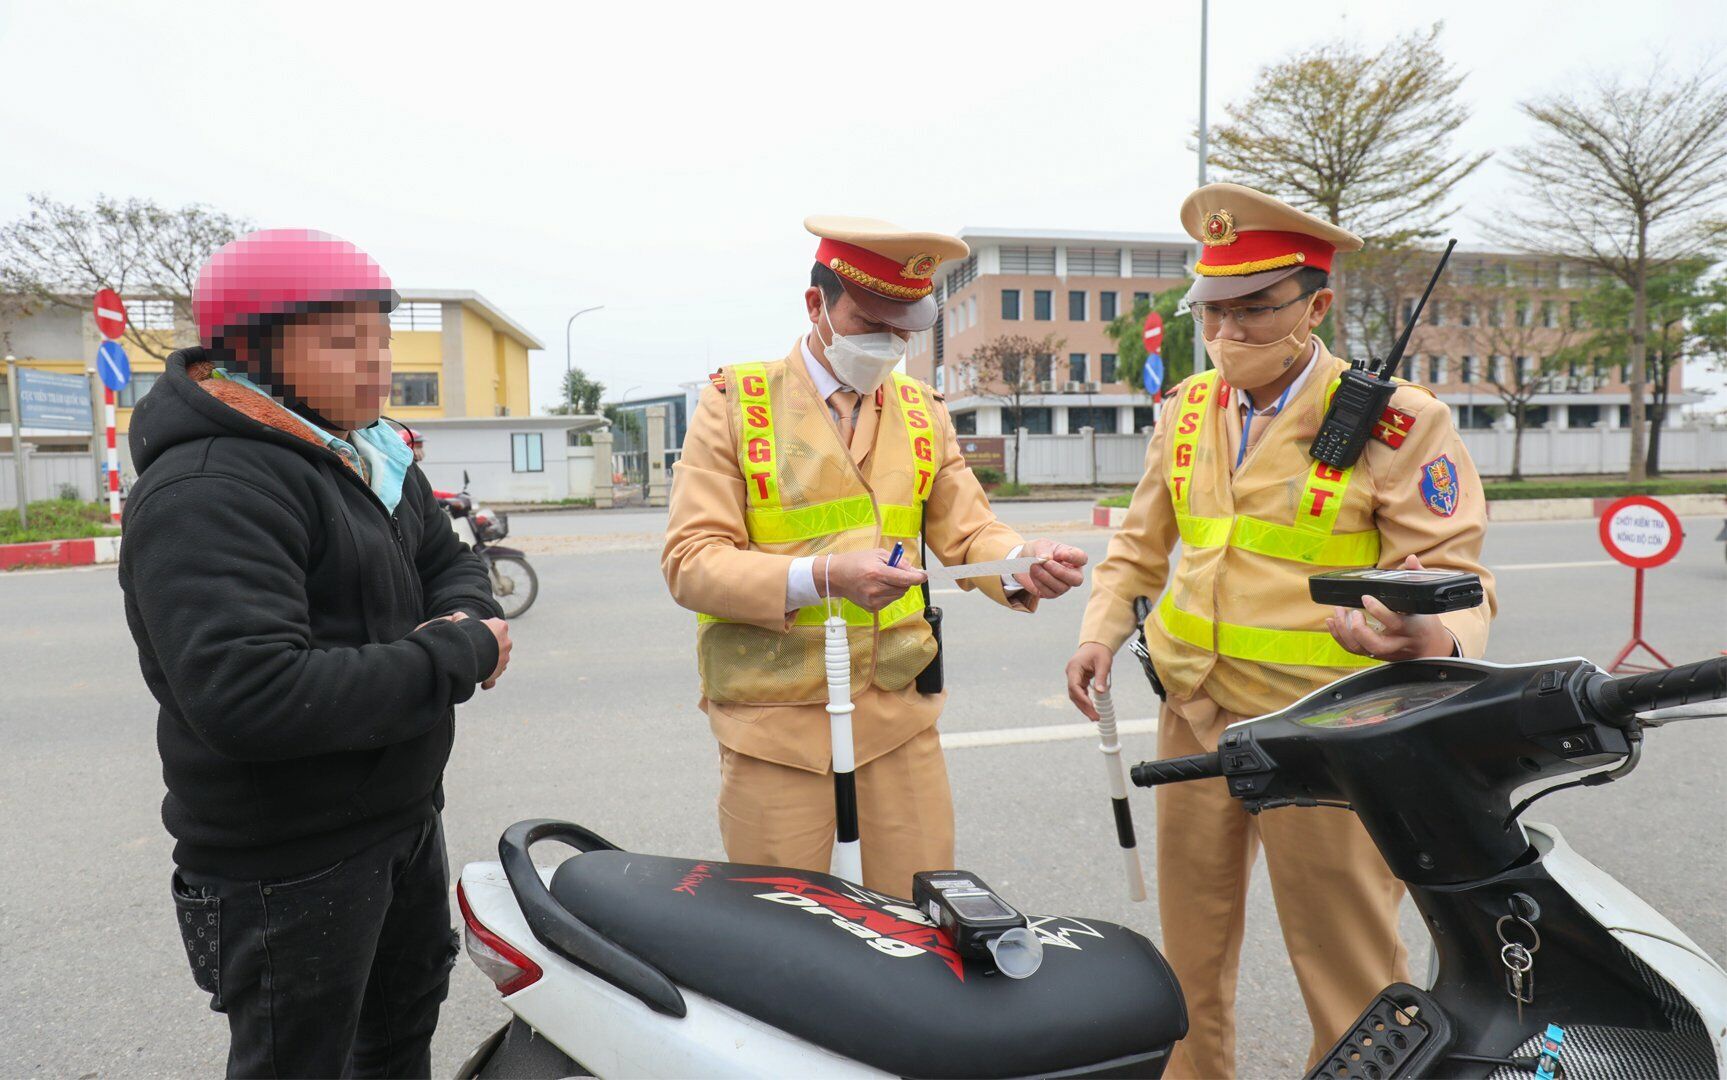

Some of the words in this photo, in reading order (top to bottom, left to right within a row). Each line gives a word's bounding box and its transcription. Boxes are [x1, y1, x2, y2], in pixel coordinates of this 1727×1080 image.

[742, 375, 771, 500] CSGT
[900, 384, 932, 495] CSGT
[1173, 382, 1208, 500] CSGT
[1653, 519, 1665, 528] TRA
